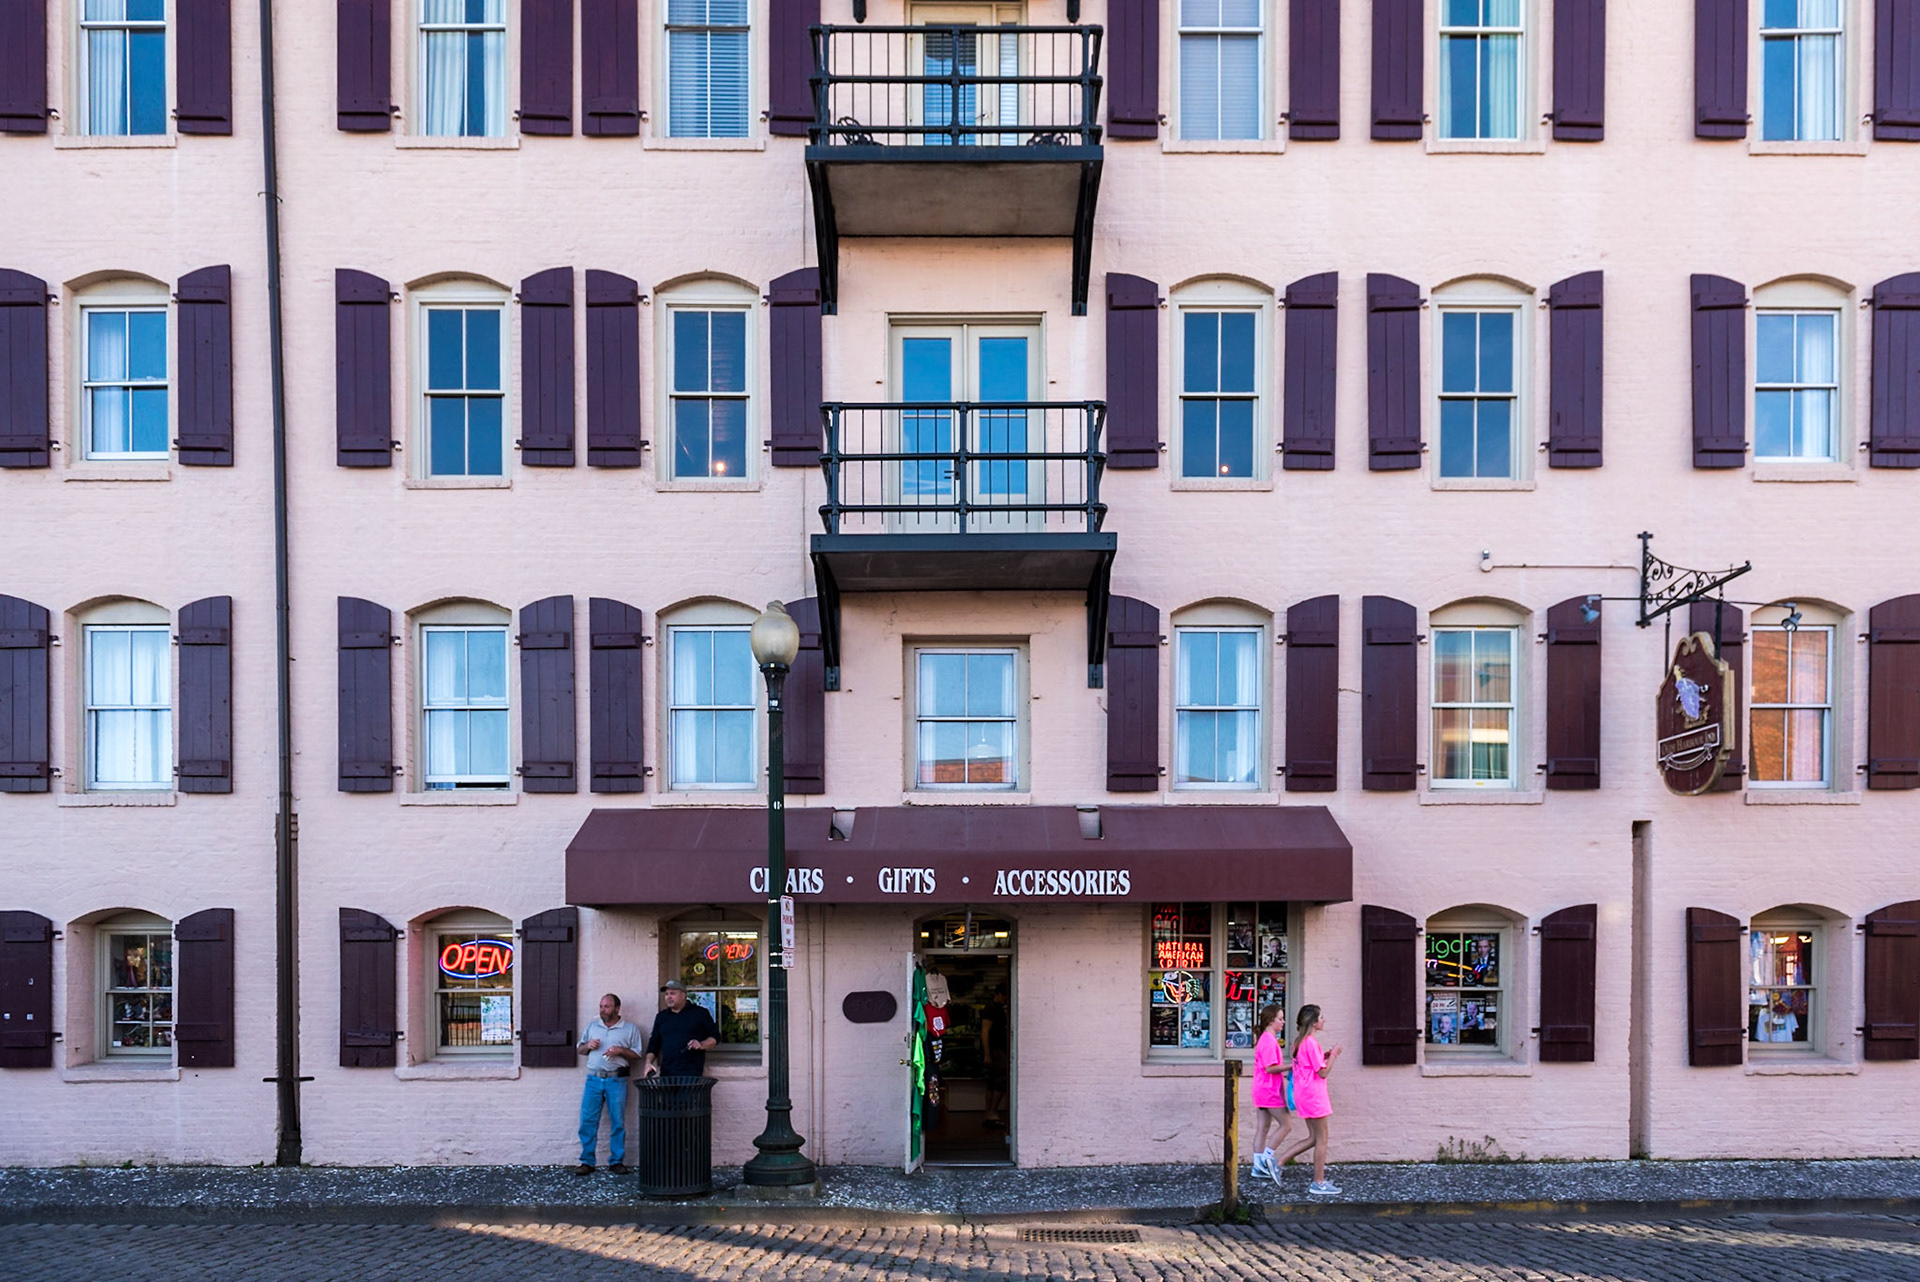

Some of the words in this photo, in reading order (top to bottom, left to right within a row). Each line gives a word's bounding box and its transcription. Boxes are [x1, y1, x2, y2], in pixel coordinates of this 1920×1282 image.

[749, 867, 824, 894] CIARS
[878, 867, 936, 894] GIFTS
[993, 869, 1132, 896] ACCESSORIES
[442, 943, 511, 975] OPEN
